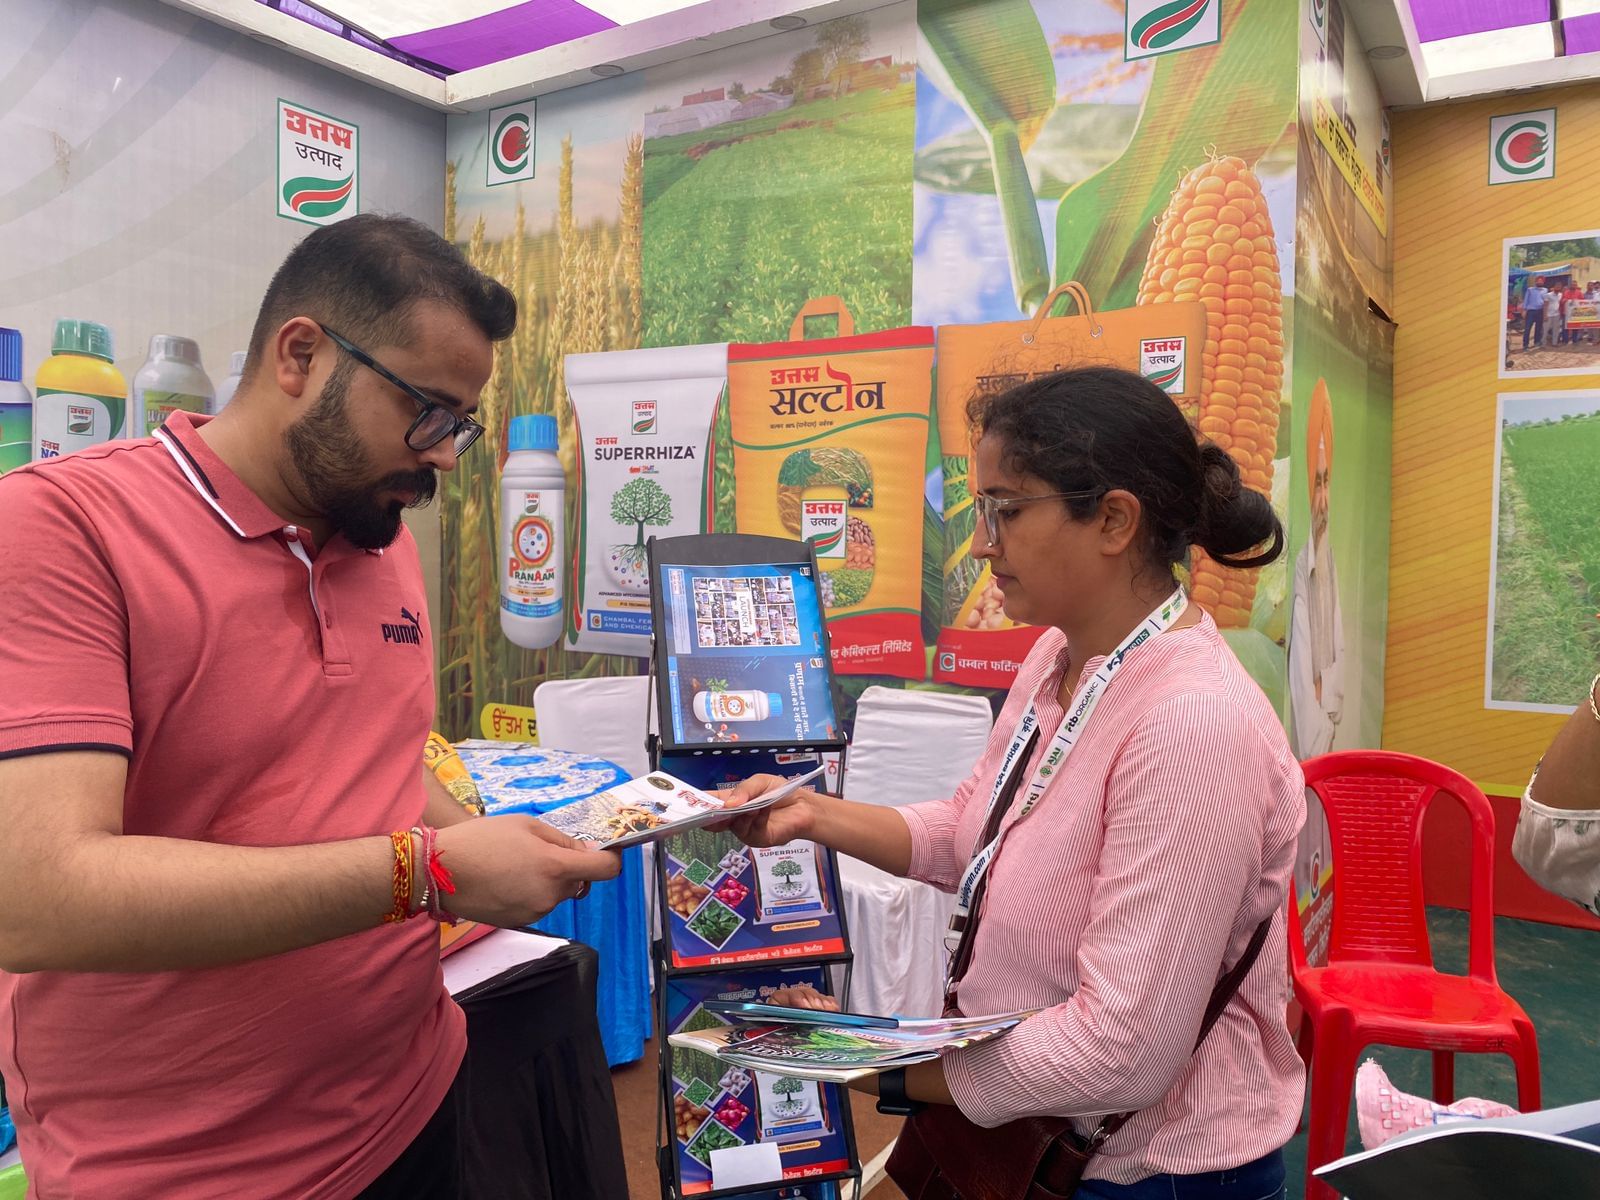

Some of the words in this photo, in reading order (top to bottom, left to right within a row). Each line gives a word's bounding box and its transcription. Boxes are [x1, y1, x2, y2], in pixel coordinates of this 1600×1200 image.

[283, 107, 353, 150] उत्तम
[294, 141, 343, 171] उत्पाद
[1143, 339, 1184, 353] उत्तम
[1149, 353, 1177, 365] उत्पाद
[770, 366, 821, 385] उत्तम
[805, 503, 844, 514] उत्तम
[810, 517, 838, 527] उत्पाद
[381, 623, 421, 646] PUMA
